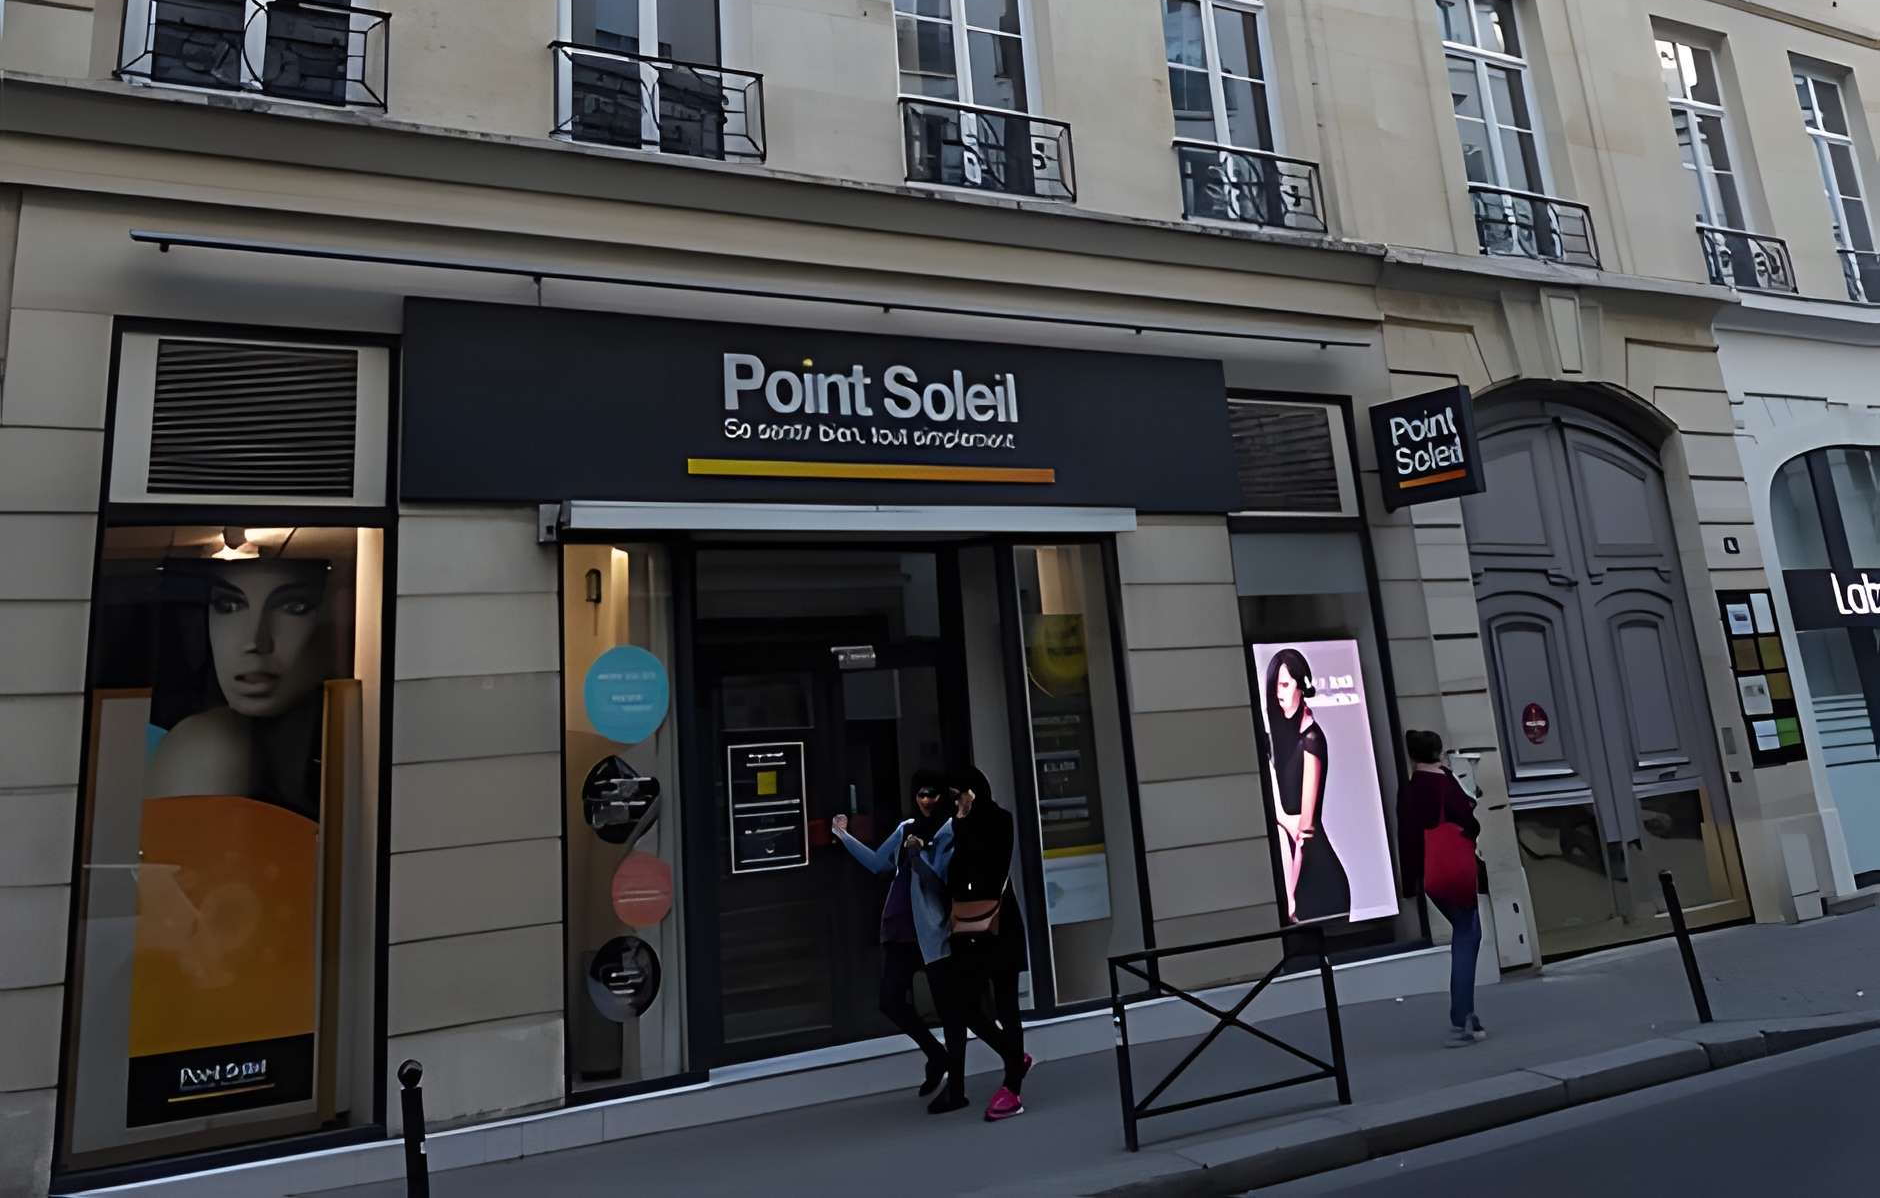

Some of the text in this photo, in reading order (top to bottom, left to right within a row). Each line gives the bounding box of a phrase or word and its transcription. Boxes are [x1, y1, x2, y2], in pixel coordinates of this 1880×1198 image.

[723, 353, 1019, 423] Point Soleil
[1389, 406, 1457, 446] Point
